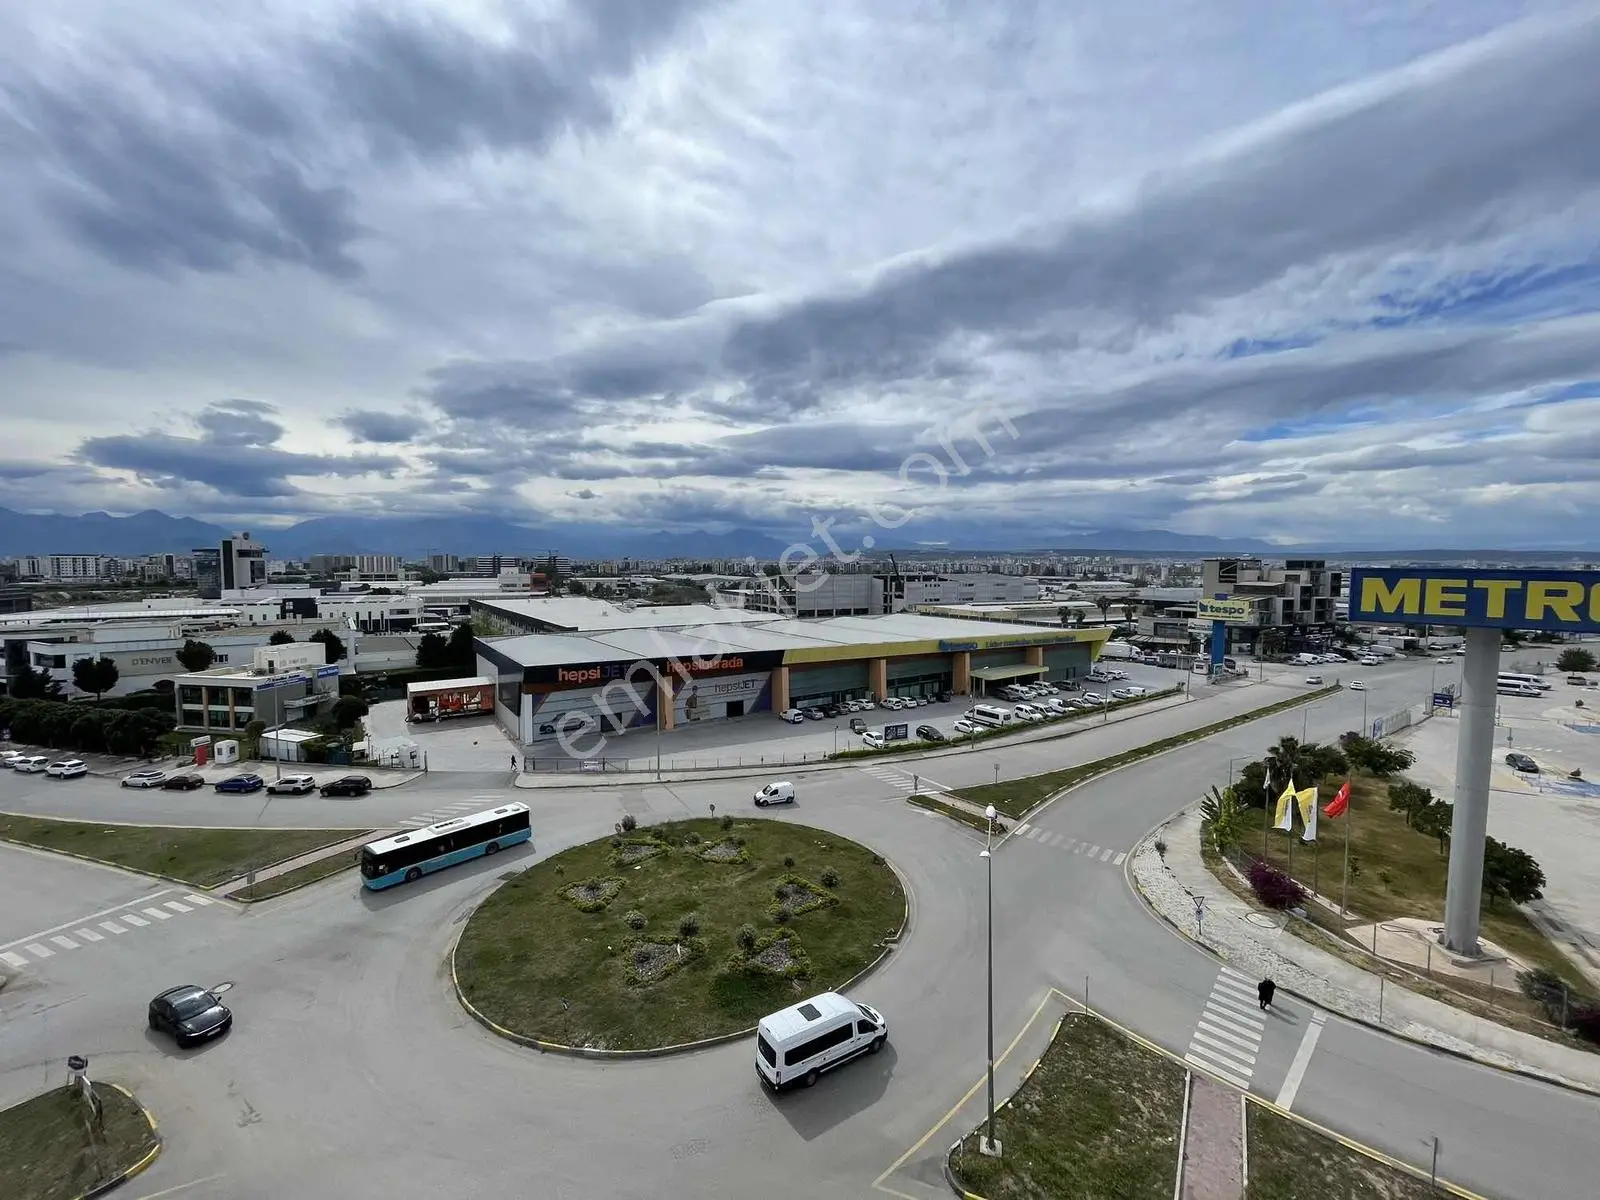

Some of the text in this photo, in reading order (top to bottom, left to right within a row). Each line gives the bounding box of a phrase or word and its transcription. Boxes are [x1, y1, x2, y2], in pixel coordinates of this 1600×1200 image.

[1360, 577, 1600, 622] METR
[1209, 604, 1245, 616] tespo
[666, 656, 744, 674] hepsiburada
[714, 678, 756, 694] hepsiJET
